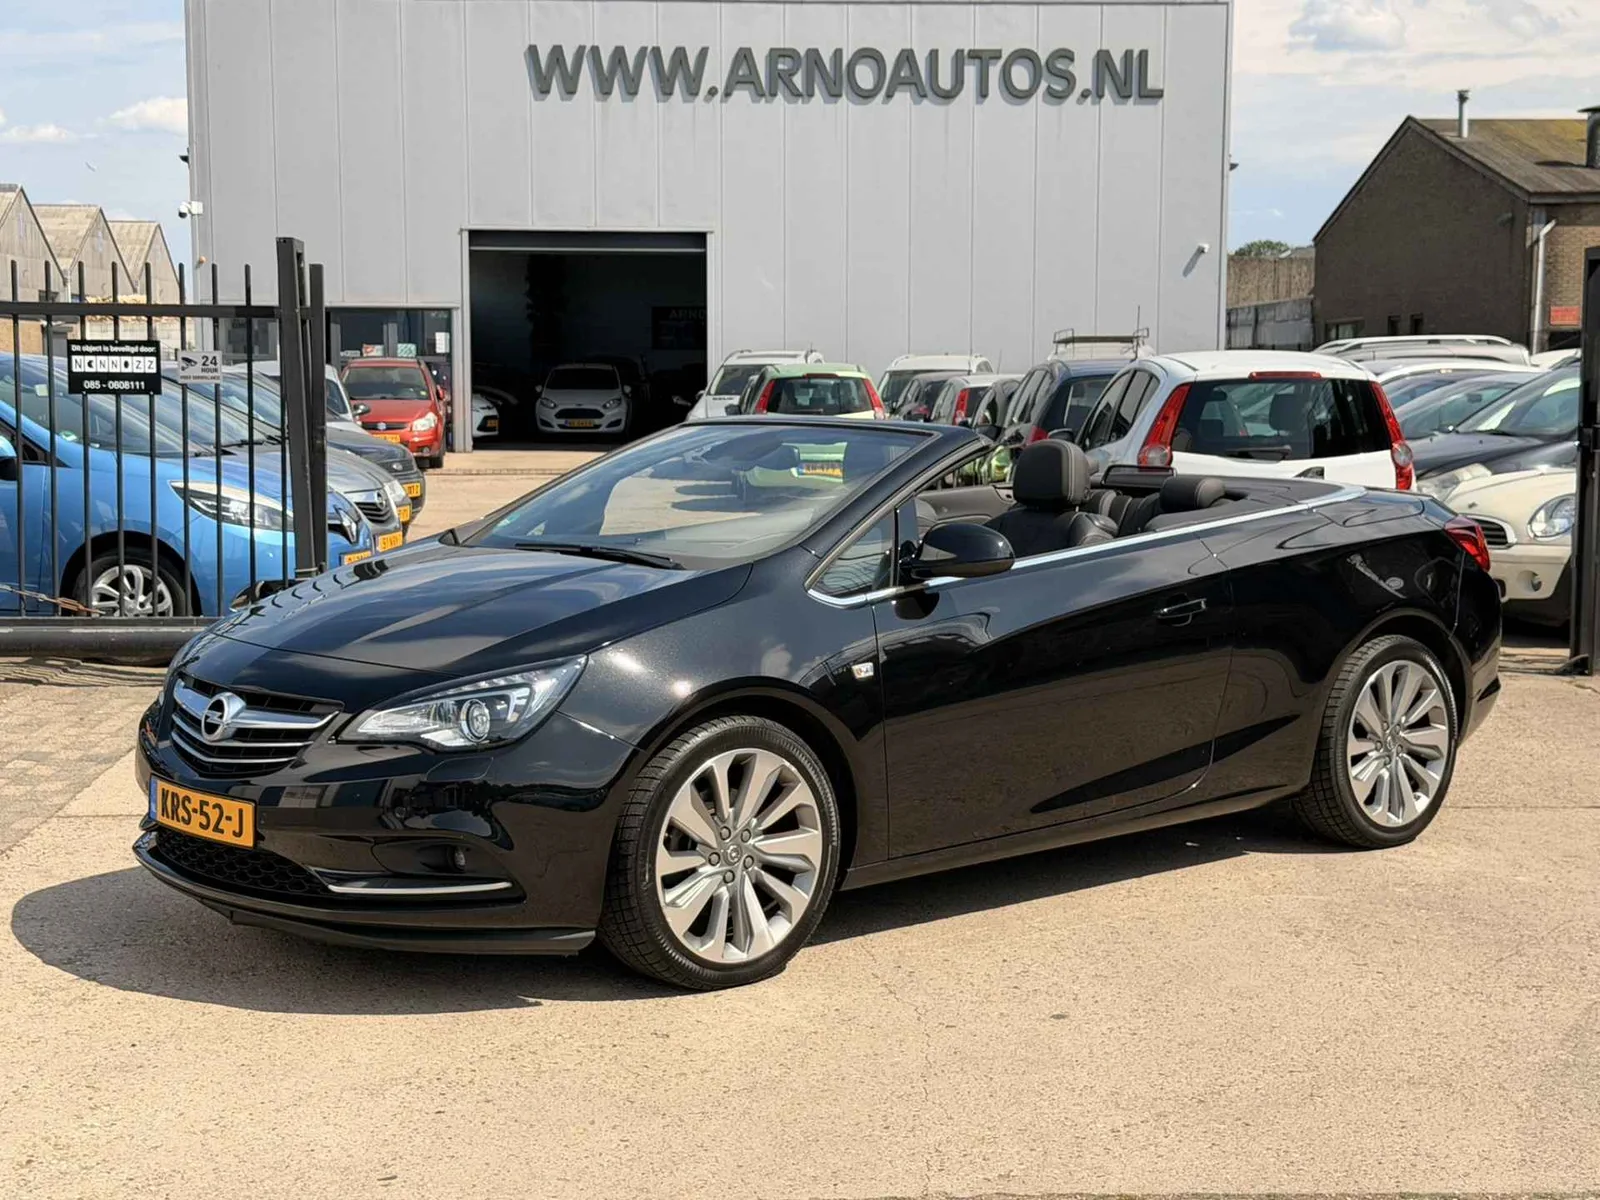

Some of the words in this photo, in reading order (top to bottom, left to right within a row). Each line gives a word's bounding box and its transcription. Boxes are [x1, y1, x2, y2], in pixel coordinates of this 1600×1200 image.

[527, 45, 1164, 100] WWW.ARNOAUTOS.NL
[82, 345, 102, 353] object
[201, 355, 218, 366] 24
[83, 380, 101, 389] 085
[160, 787, 244, 839] KRS-52-J
